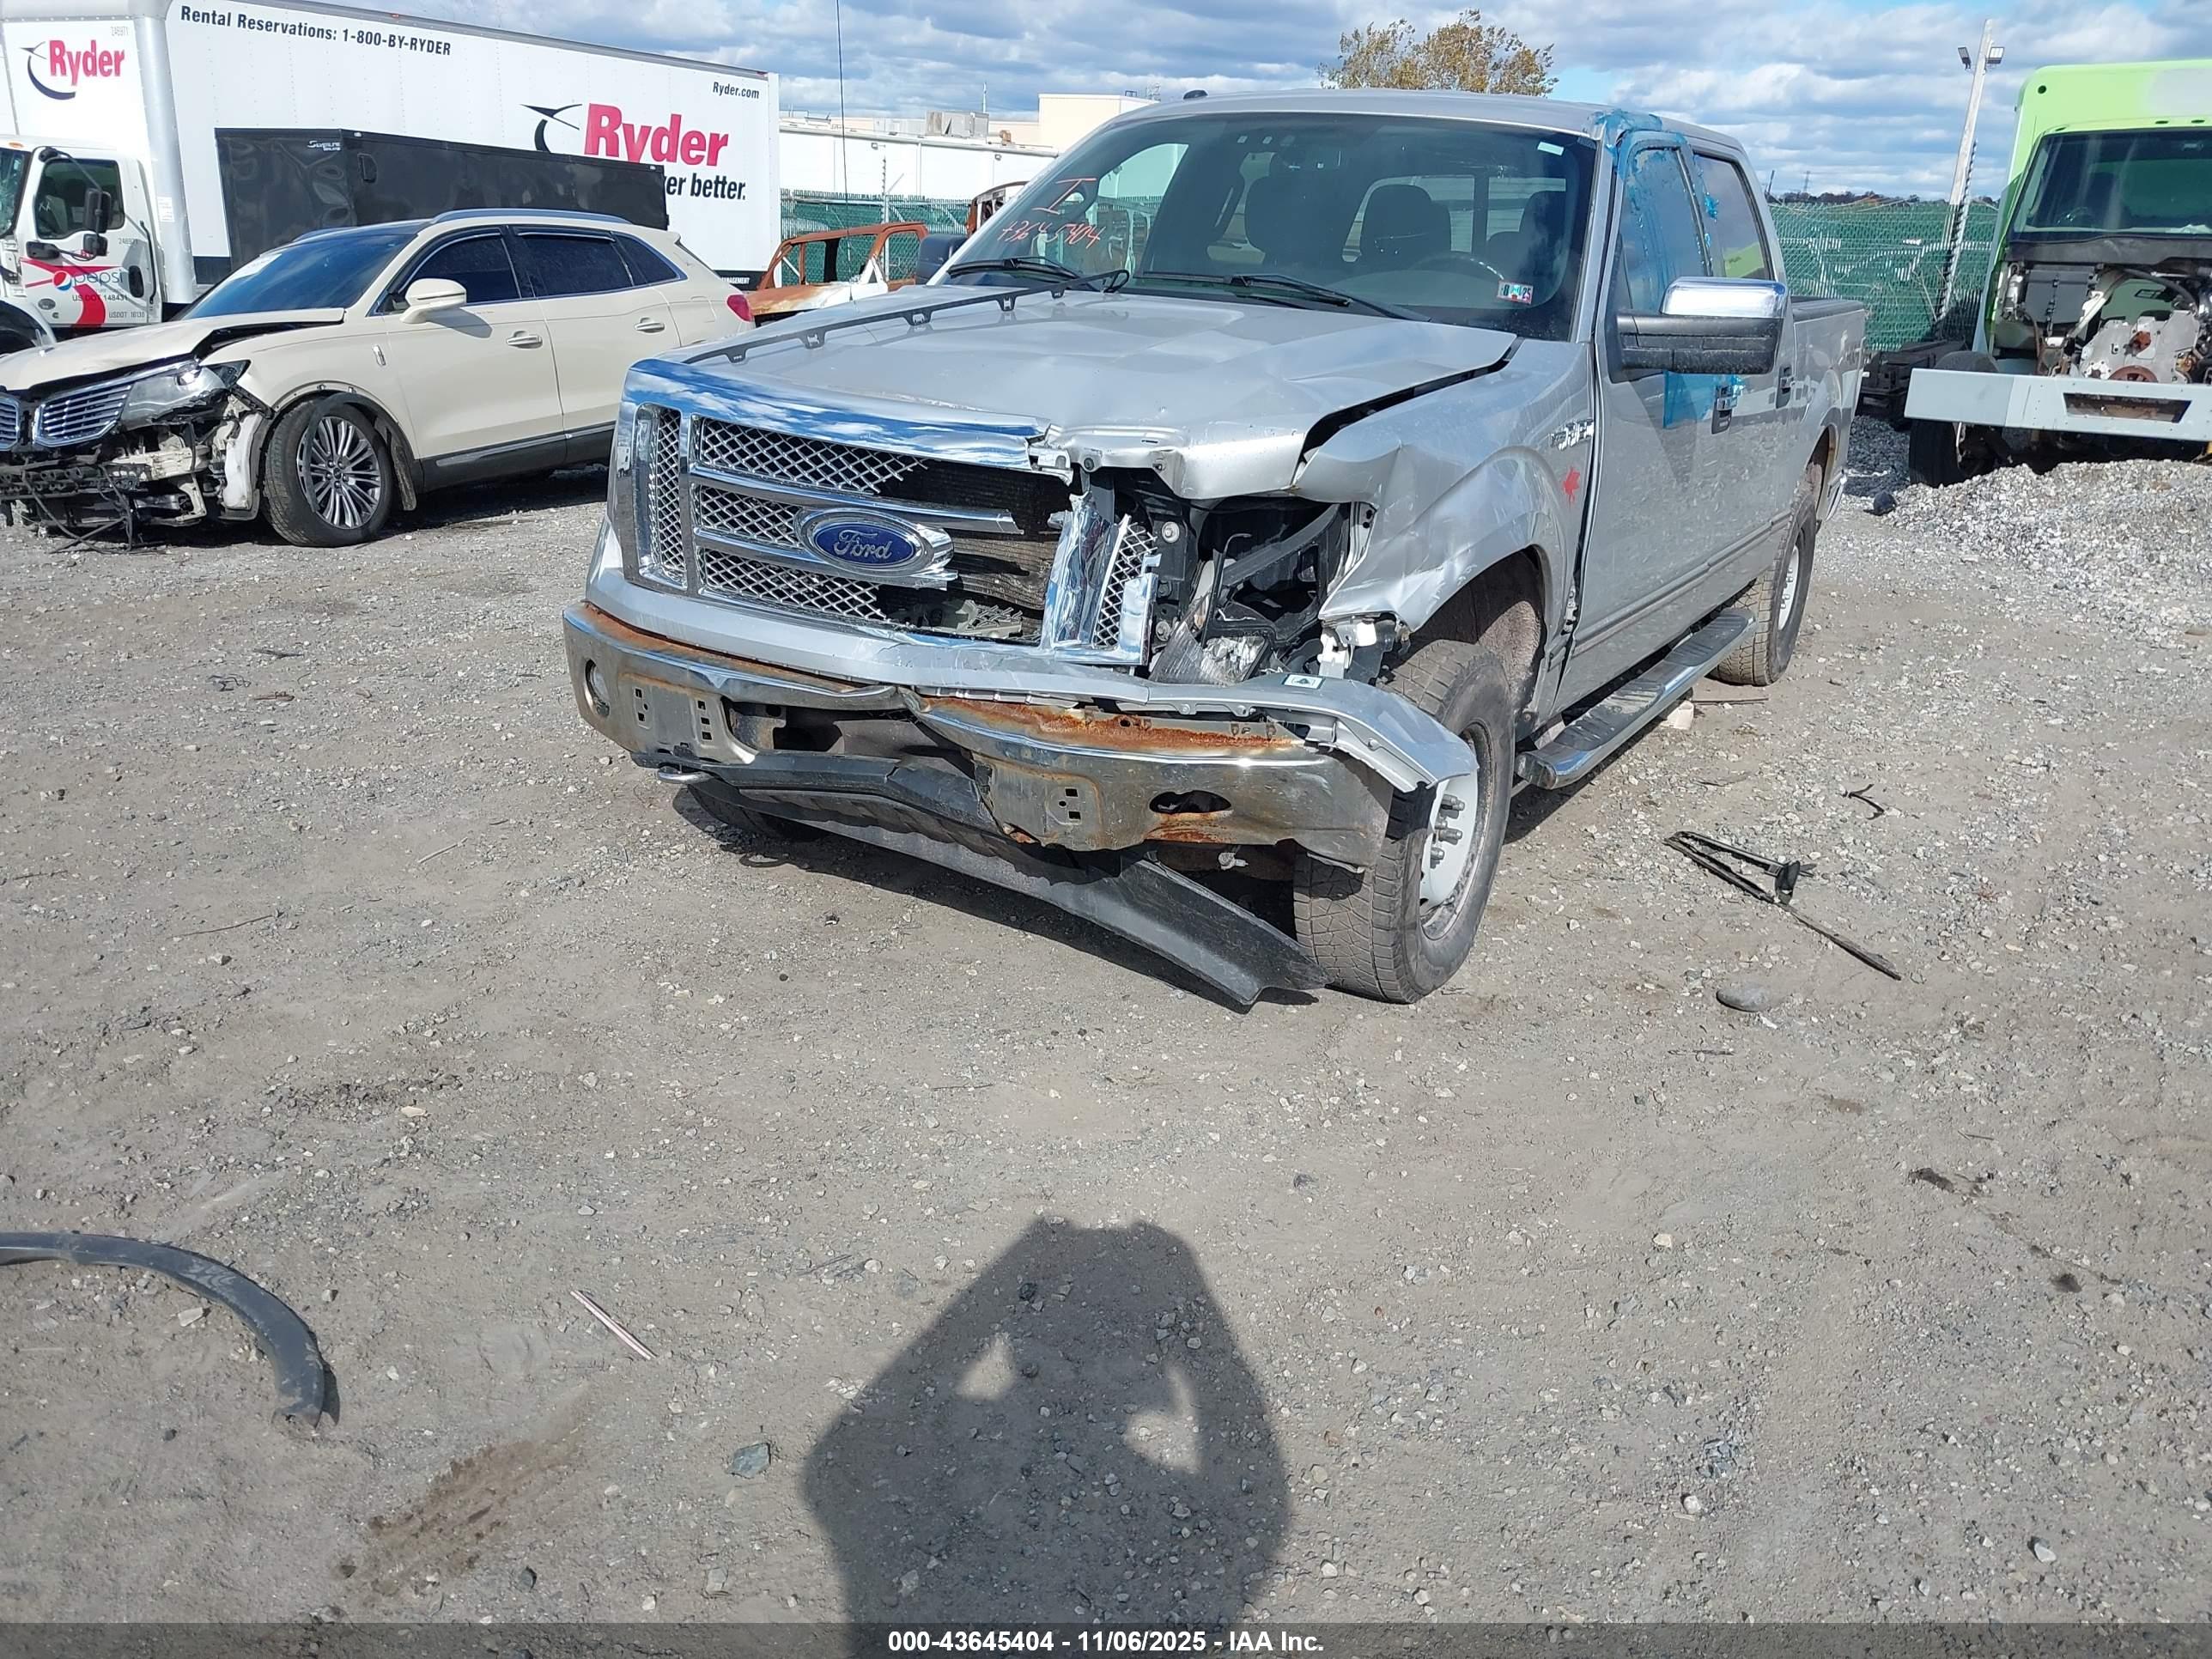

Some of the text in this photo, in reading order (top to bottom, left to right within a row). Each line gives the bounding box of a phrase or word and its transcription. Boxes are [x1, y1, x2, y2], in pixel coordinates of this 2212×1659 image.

[180, 5, 452, 56] Rental Reservations: 1-800-BY-RYDER
[49, 40, 125, 87] Ryder
[712, 82, 760, 100] Ryder.com
[584, 102, 729, 167] Ryder
[690, 173, 746, 200] better.
[74, 269, 124, 286] pepsi
[833, 529, 893, 560] Ford
